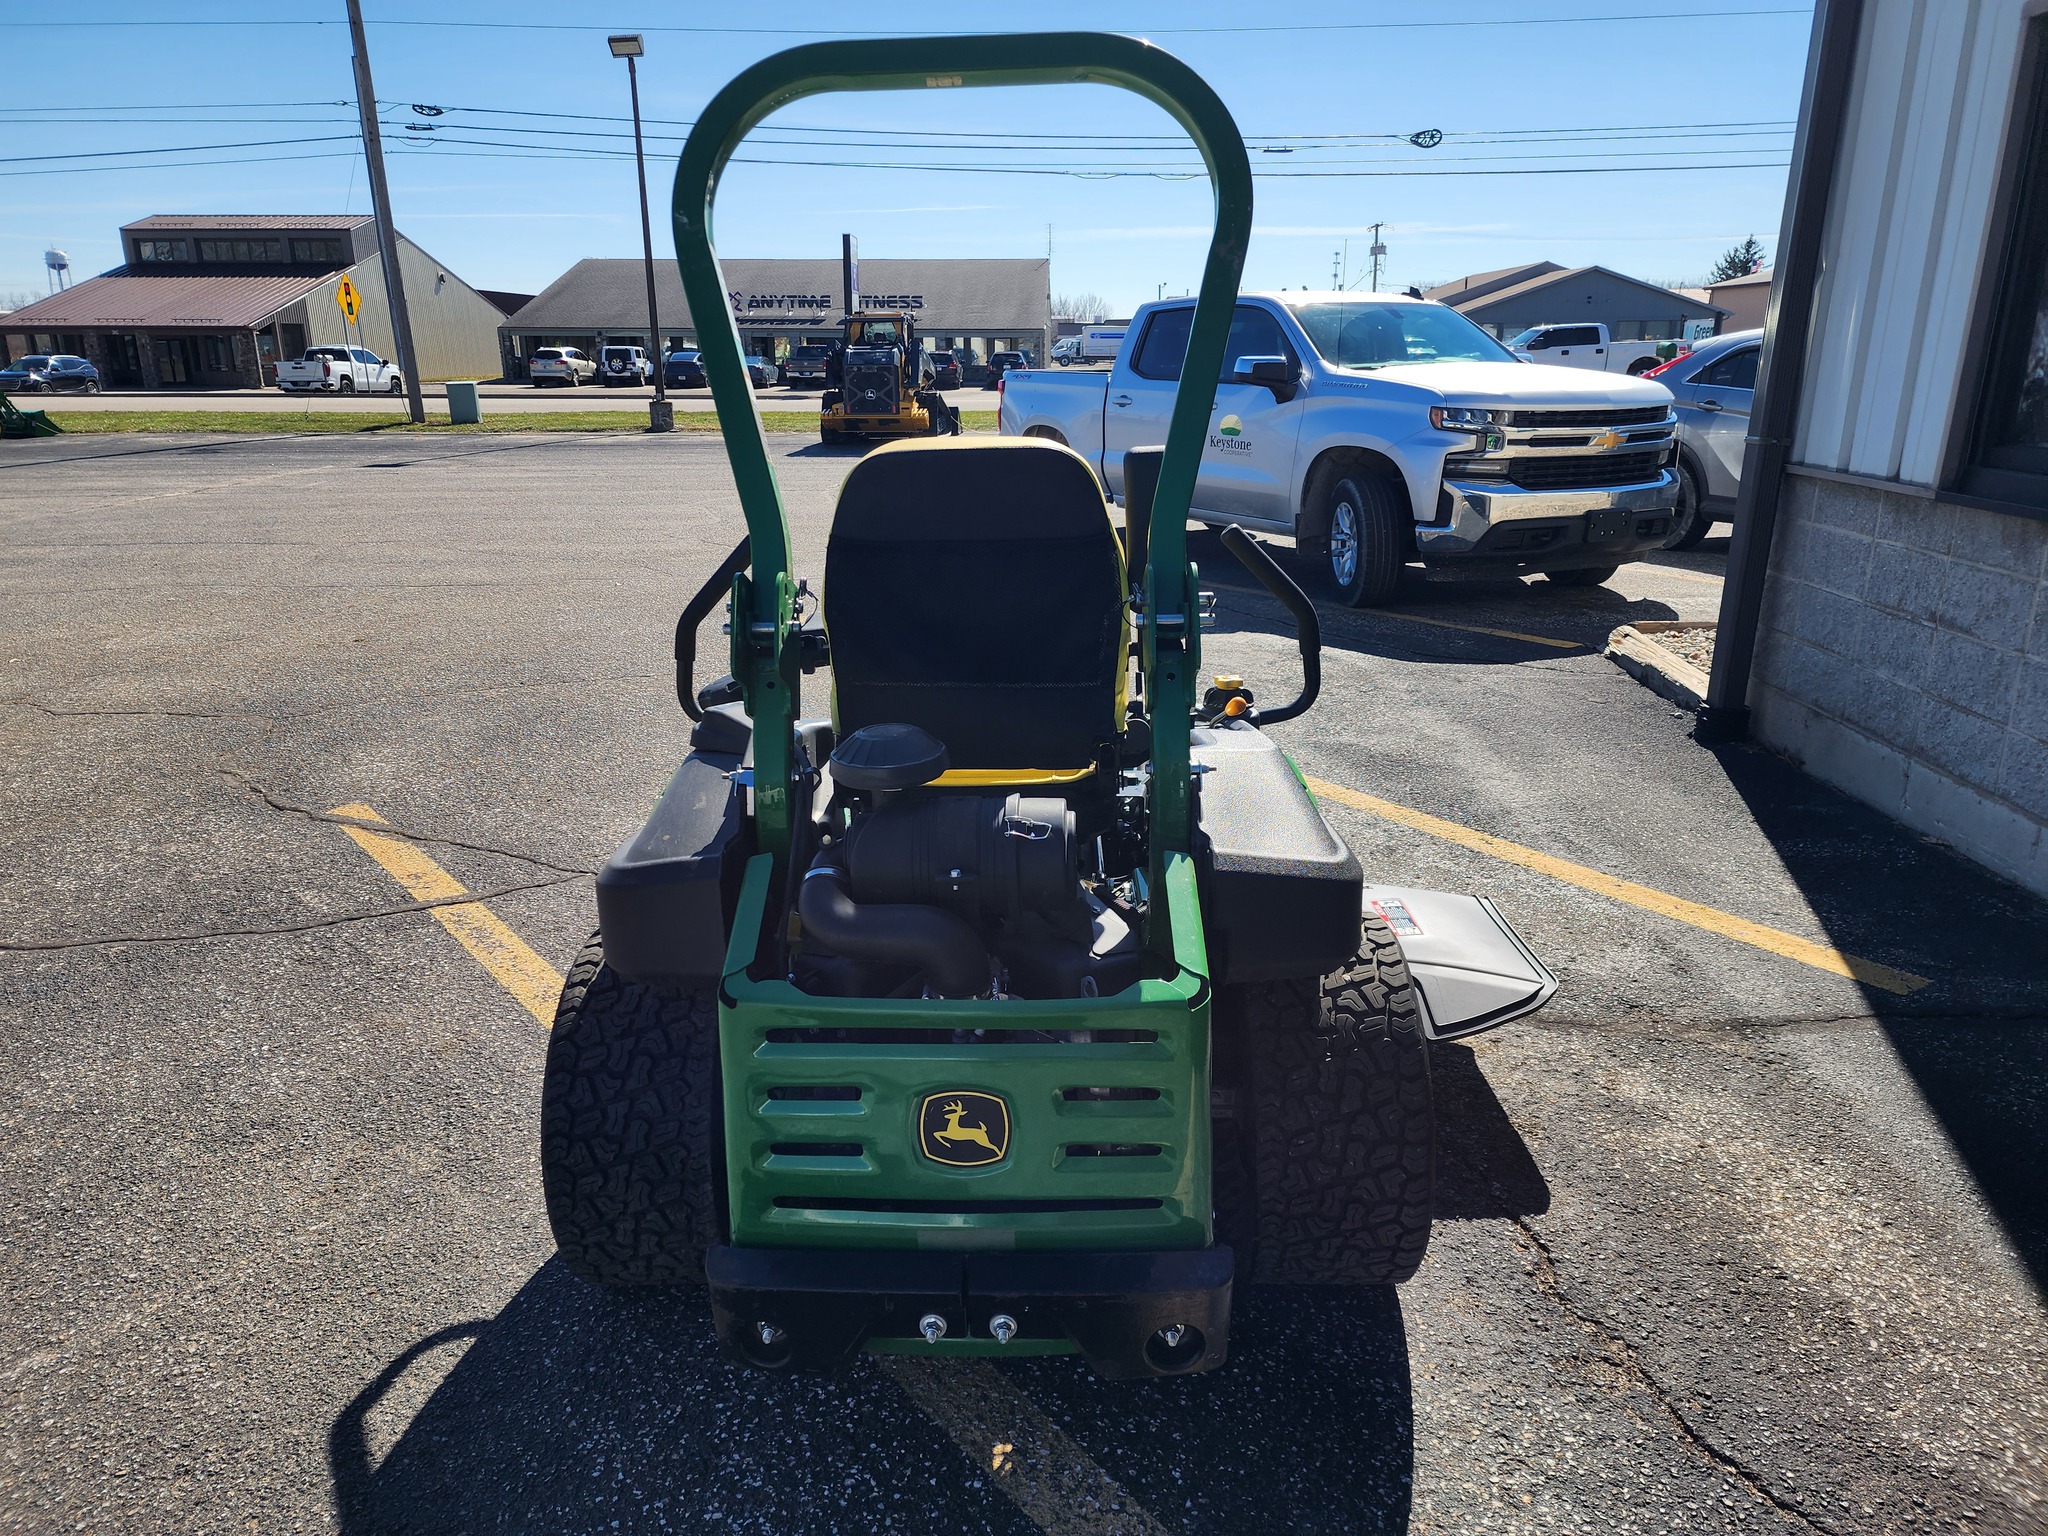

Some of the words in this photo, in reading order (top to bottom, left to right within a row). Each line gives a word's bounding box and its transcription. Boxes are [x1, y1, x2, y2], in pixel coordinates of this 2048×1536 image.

[748, 295, 831, 308] ANYTIME
[859, 295, 923, 308] ITNESS
[1210, 435, 1252, 451] Keystone
